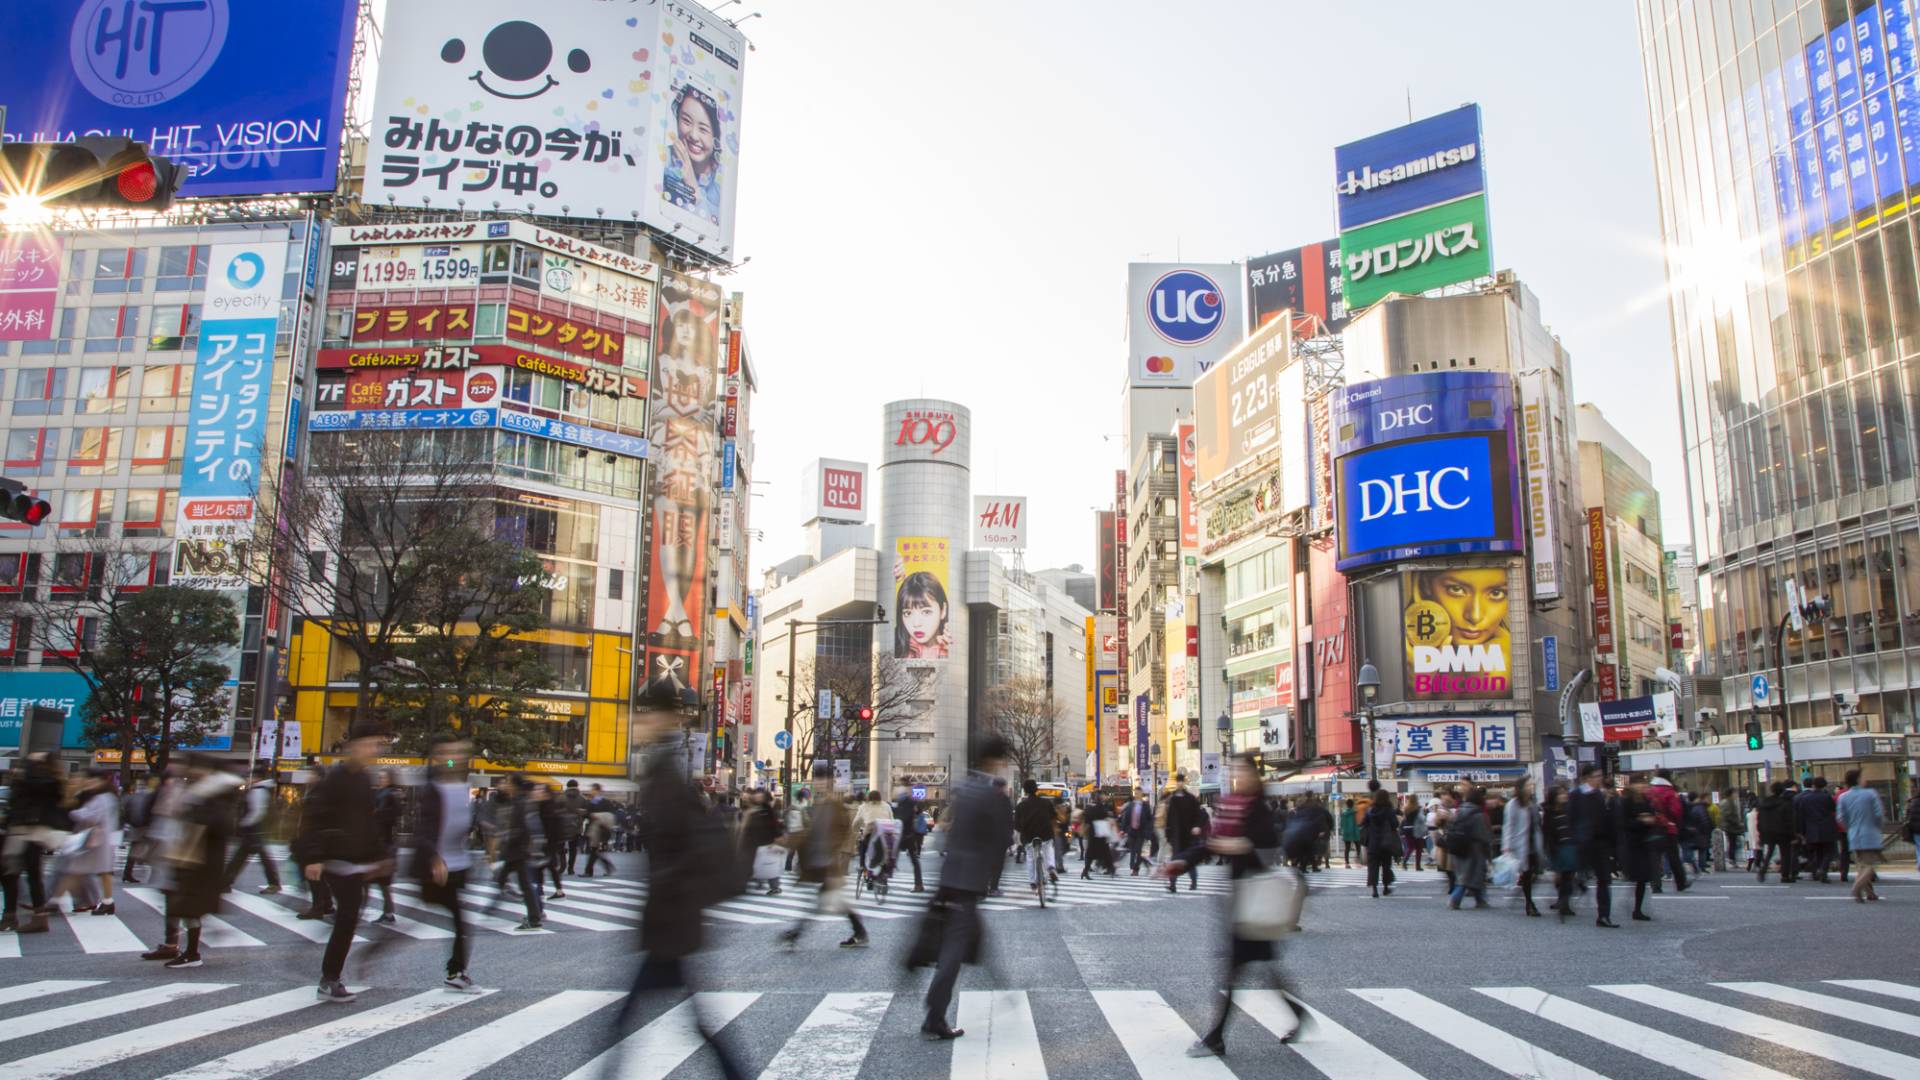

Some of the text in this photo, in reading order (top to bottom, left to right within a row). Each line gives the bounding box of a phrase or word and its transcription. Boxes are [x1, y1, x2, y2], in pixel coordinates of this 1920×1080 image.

[216, 119, 321, 147] VISION
[384, 115, 636, 167] みんなの今が、
[381, 154, 559, 199] ライブ中。
[1336, 143, 1476, 194] Hisamitsu
[350, 224, 476, 242] しゃぶしゃぶバイキング
[1346, 221, 1479, 281] サロンパス
[334, 261, 356, 276] 9F
[213, 293, 272, 309] eyecity
[356, 308, 470, 333] プライス
[508, 309, 620, 355] コンタクト
[422, 346, 479, 369] ガスト
[318, 384, 345, 401] 7F
[352, 383, 382, 396] Café
[385, 377, 456, 407] ガスト
[470, 385, 494, 395] ガスト
[586, 368, 637, 399] ガスト
[1350, 386, 1382, 402] Channel
[194, 334, 238, 482] アイシティ
[228, 333, 266, 481] コンタクトの
[1232, 374, 1268, 428] 2.23
[316, 414, 349, 426] AEON
[361, 412, 465, 428] 英会話イーオン
[505, 413, 542, 431] AEON
[906, 411, 955, 421] SHIBUYA
[1380, 404, 1433, 431] DHC
[895, 418, 957, 455] 109
[1525, 398, 1546, 537] Taisei neon
[828, 473, 856, 489] UNI
[828, 489, 858, 506] QLO
[1359, 466, 1470, 522] DHC
[980, 503, 1020, 529] H&M
[984, 535, 1008, 543] 150m
[1405, 548, 1422, 556] DHC
[1413, 643, 1506, 673] DMM
[1414, 673, 1506, 693] Bitcoin
